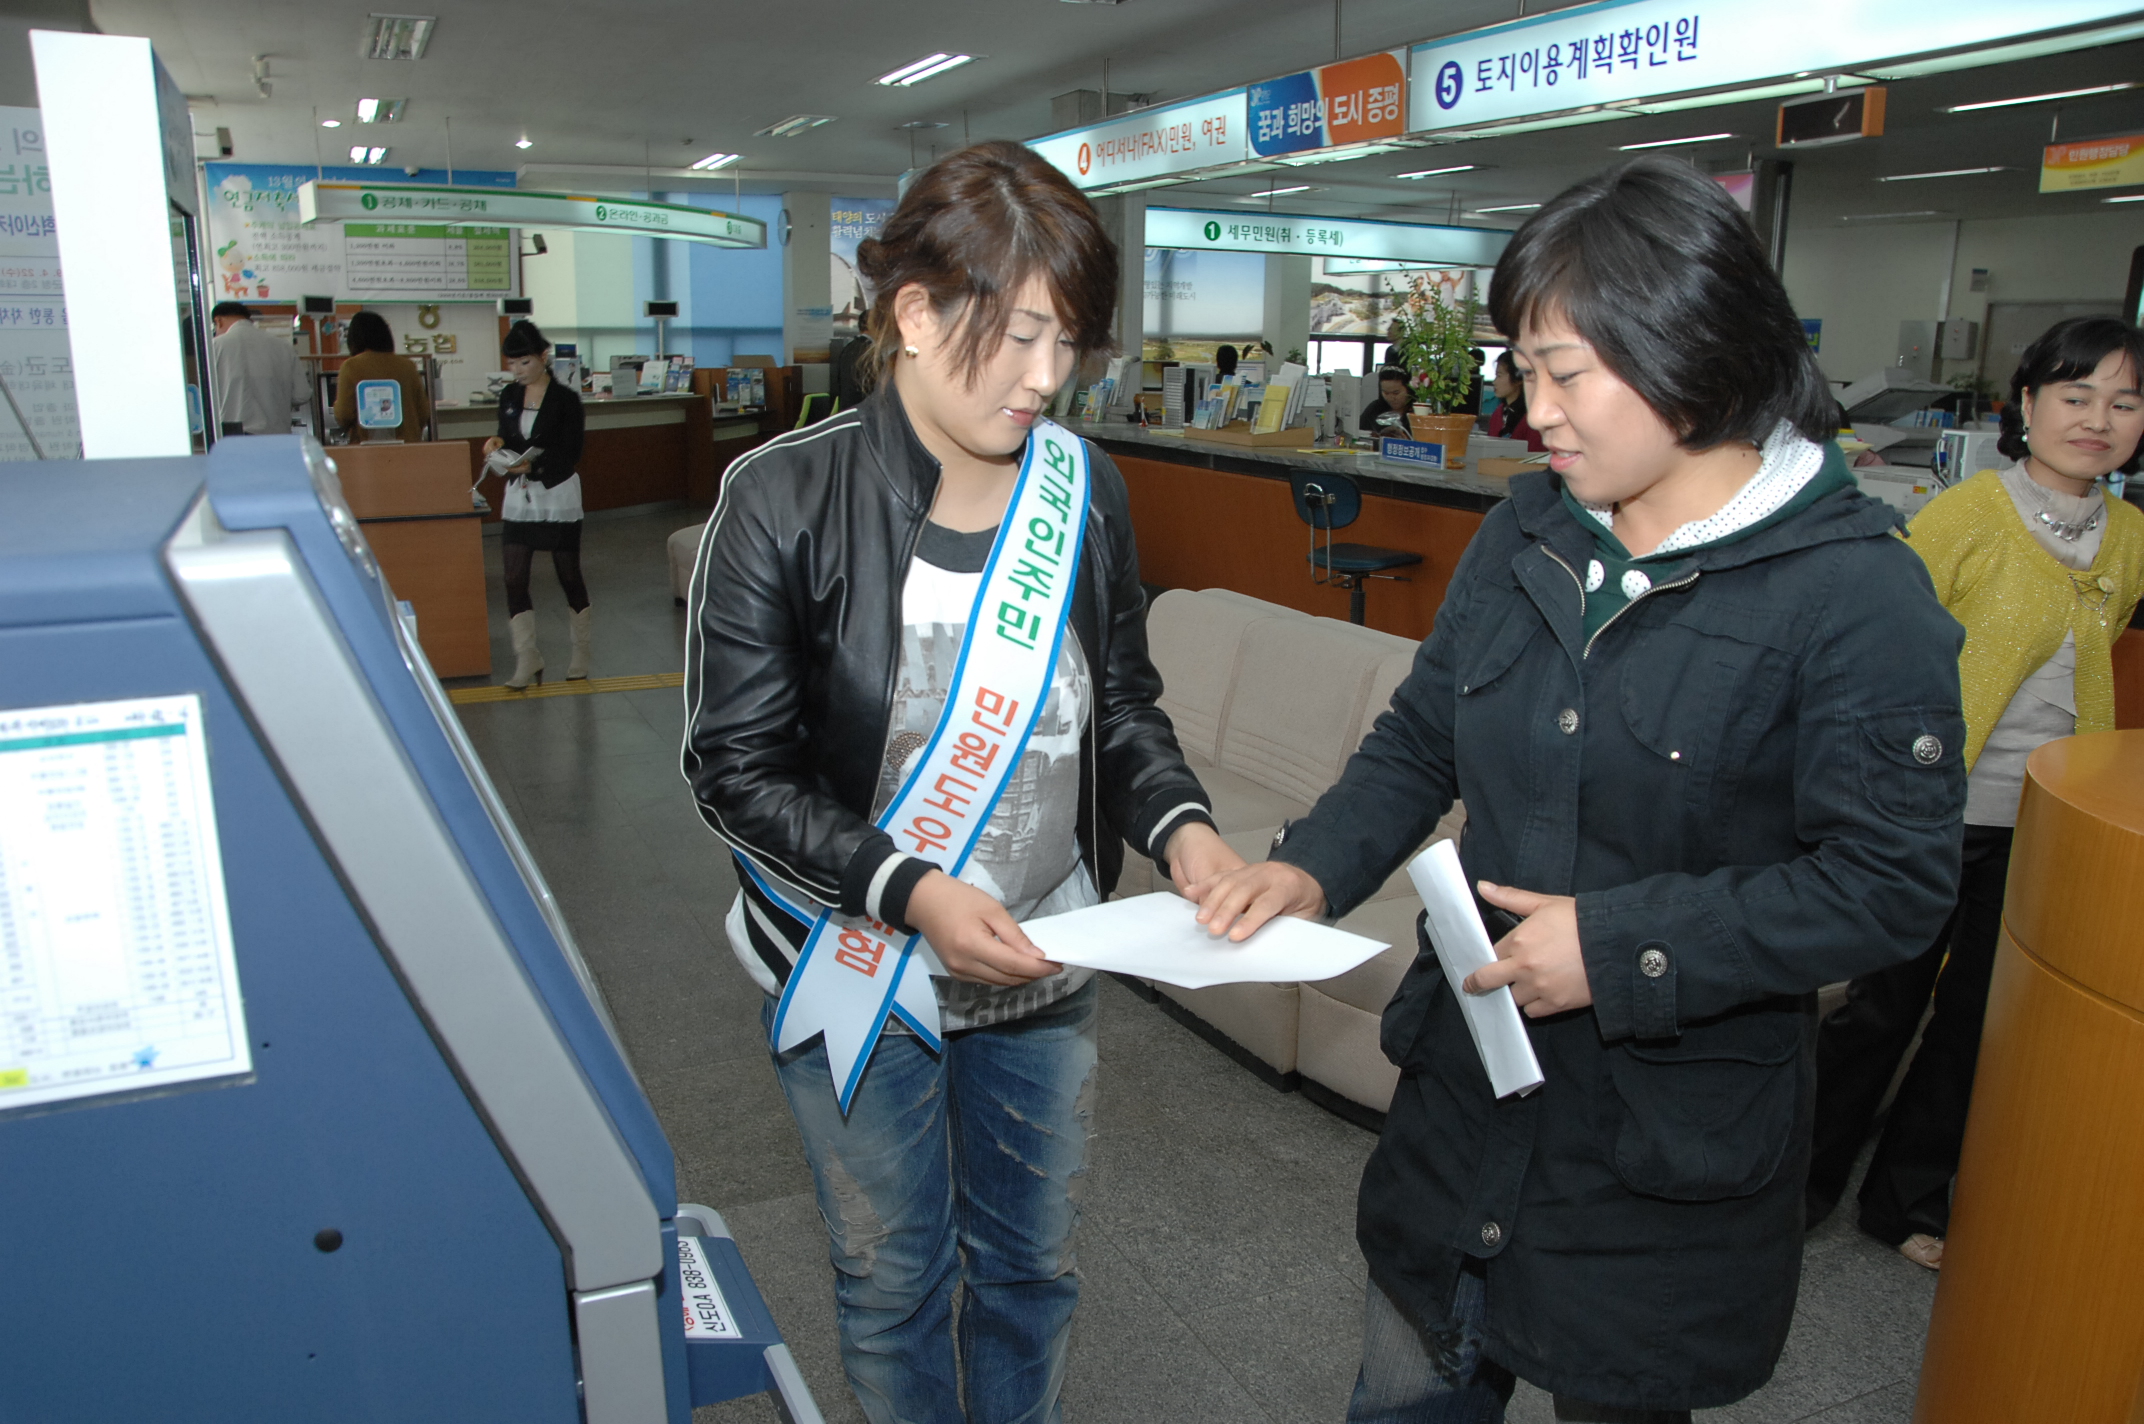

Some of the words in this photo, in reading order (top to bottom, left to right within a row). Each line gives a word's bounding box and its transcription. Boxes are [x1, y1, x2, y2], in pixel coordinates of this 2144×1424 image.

[1474, 15, 1699, 92] 토지이용계획확인원
[1202, 115, 1226, 146] 여권
[1257, 106, 1285, 143] 꿈과
[1287, 97, 1329, 136] 희망의
[1333, 90, 1363, 126] 도시
[1368, 83, 1400, 123] 증평
[832, 211, 863, 225] 태양의
[404, 333, 457, 355] 농협
[997, 438, 1074, 651] 외국인주민
